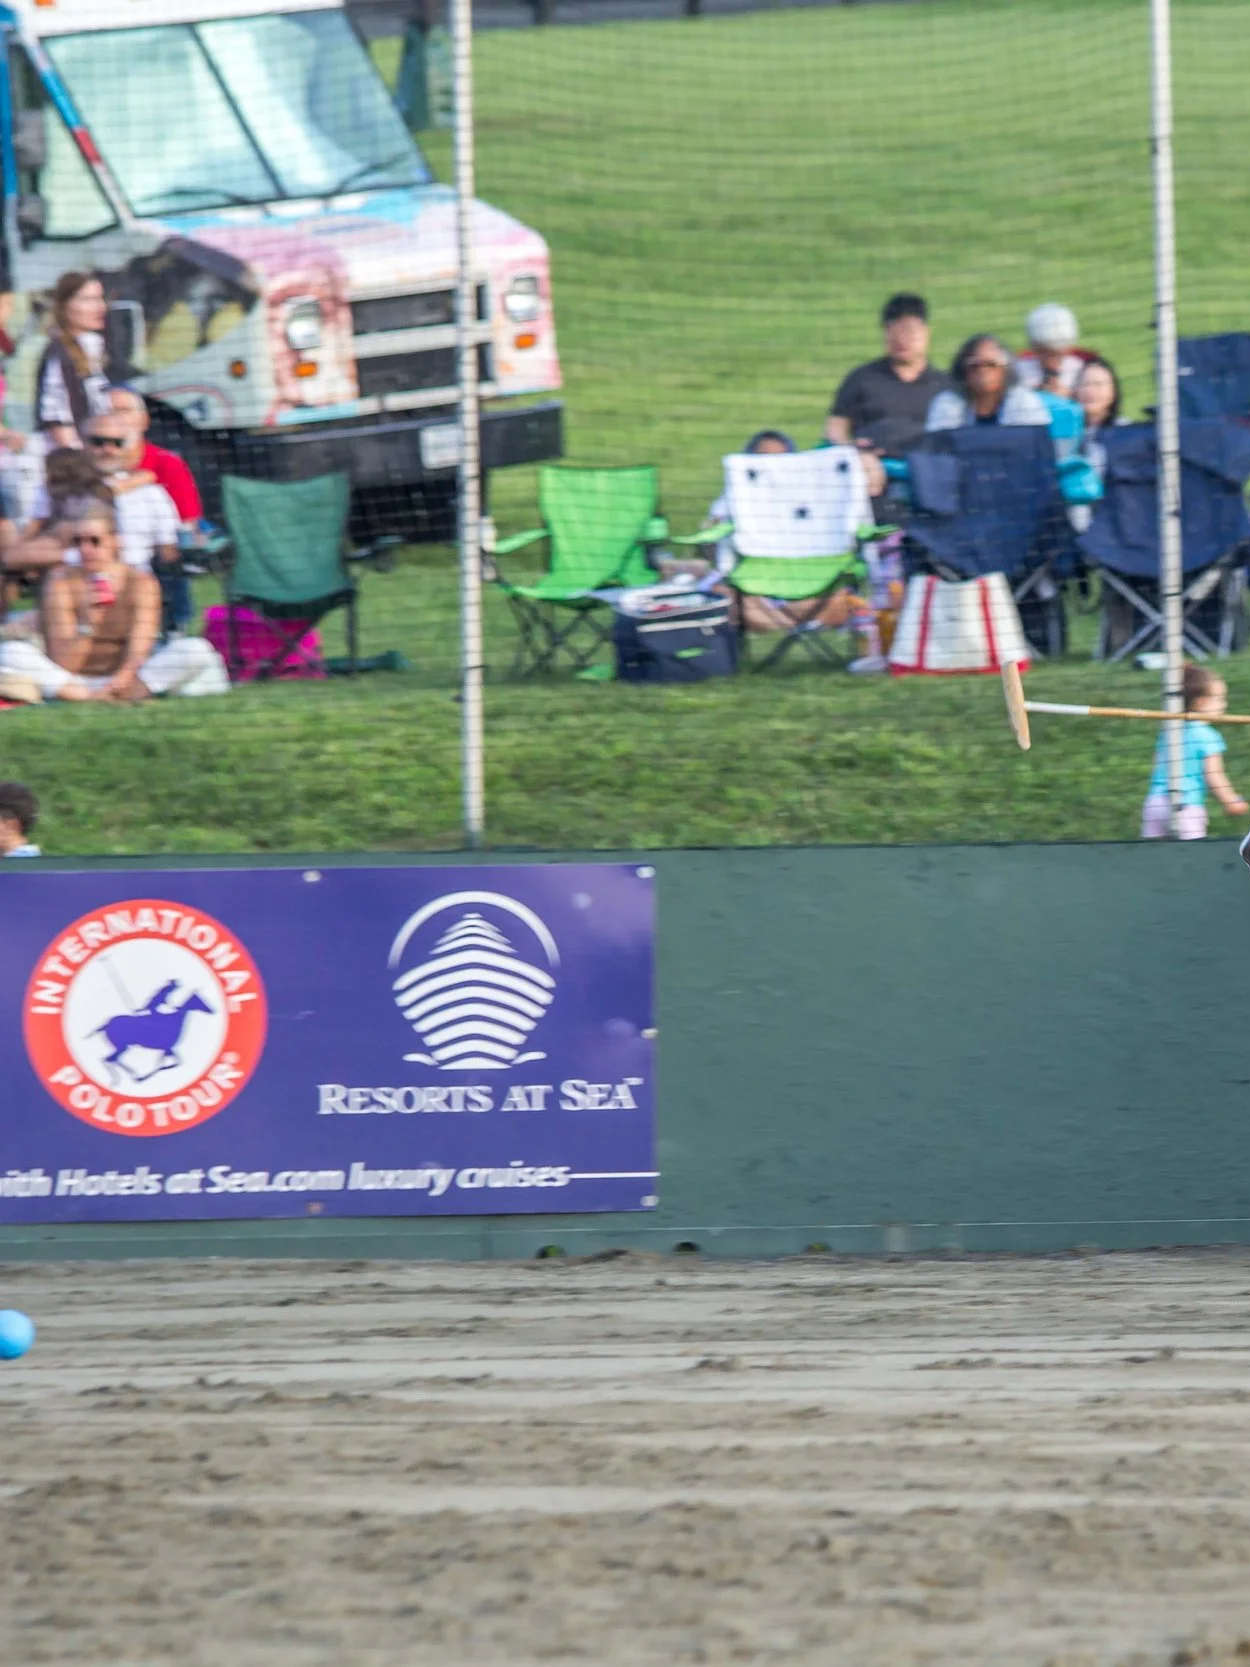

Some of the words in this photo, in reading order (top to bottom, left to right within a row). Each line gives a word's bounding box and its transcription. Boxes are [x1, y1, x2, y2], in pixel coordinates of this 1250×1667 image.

[30, 907, 258, 1014] INTERNATIONAL
[48, 1064, 146, 1128] POLO
[146, 1061, 245, 1127] TOUR
[54, 1166, 164, 1197] Hotels
[164, 1168, 206, 1195] at
[205, 1164, 346, 1194] Sea.com
[347, 1161, 456, 1197] luxury
[456, 1160, 571, 1189] cruises
